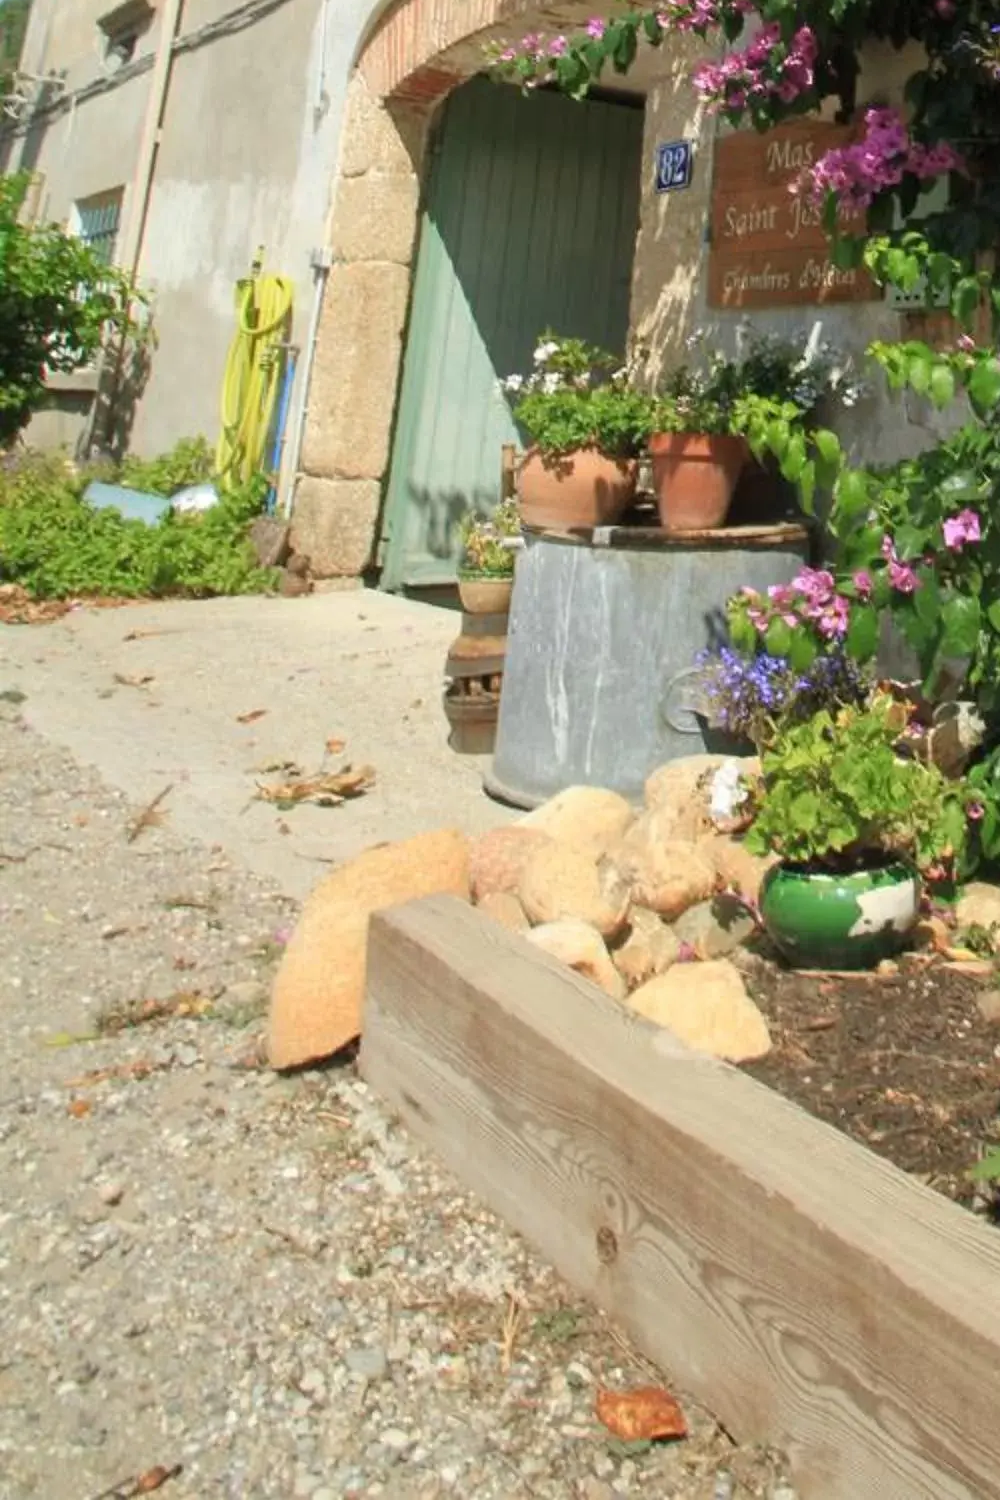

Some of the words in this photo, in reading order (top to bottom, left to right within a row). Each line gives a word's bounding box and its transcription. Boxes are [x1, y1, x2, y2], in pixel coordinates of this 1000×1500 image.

[661, 147, 686, 185] 82
[767, 139, 815, 172] Mas
[724, 203, 777, 237] Saint
